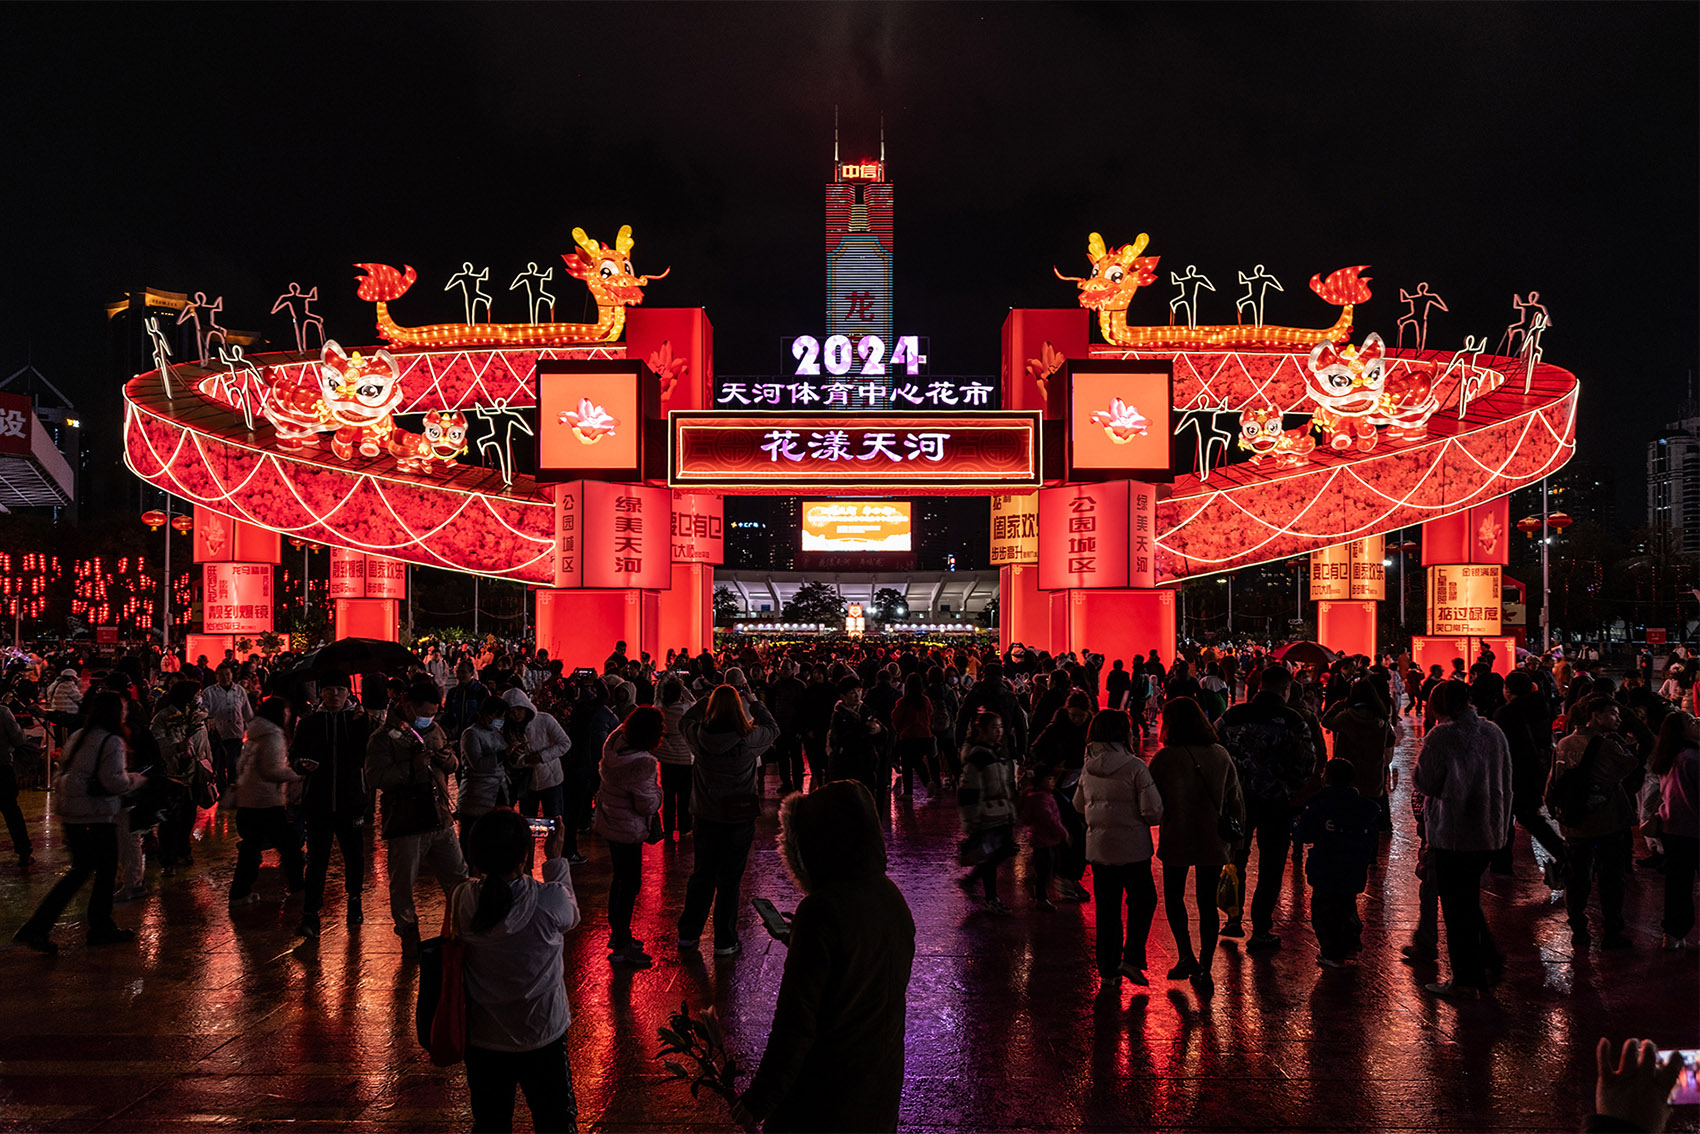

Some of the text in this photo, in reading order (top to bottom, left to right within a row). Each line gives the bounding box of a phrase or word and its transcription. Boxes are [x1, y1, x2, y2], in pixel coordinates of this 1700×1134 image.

[842, 164, 877, 178] 中信
[845, 291, 875, 321] 龙
[791, 335, 926, 375] 2024
[717, 382, 994, 405] 天河体育中心花市
[761, 430, 951, 462] 花漾天河
[562, 494, 574, 573] 公园城区
[615, 496, 642, 573] 绿美天河
[993, 513, 1038, 540] 阖家欢
[1068, 496, 1096, 573] 公园城区
[1136, 494, 1148, 573] 绿美天河
[992, 545, 1022, 560] 步步高升
[208, 605, 268, 619] 靓到爆镜
[1438, 607, 1498, 620] 掂过碌蔗
